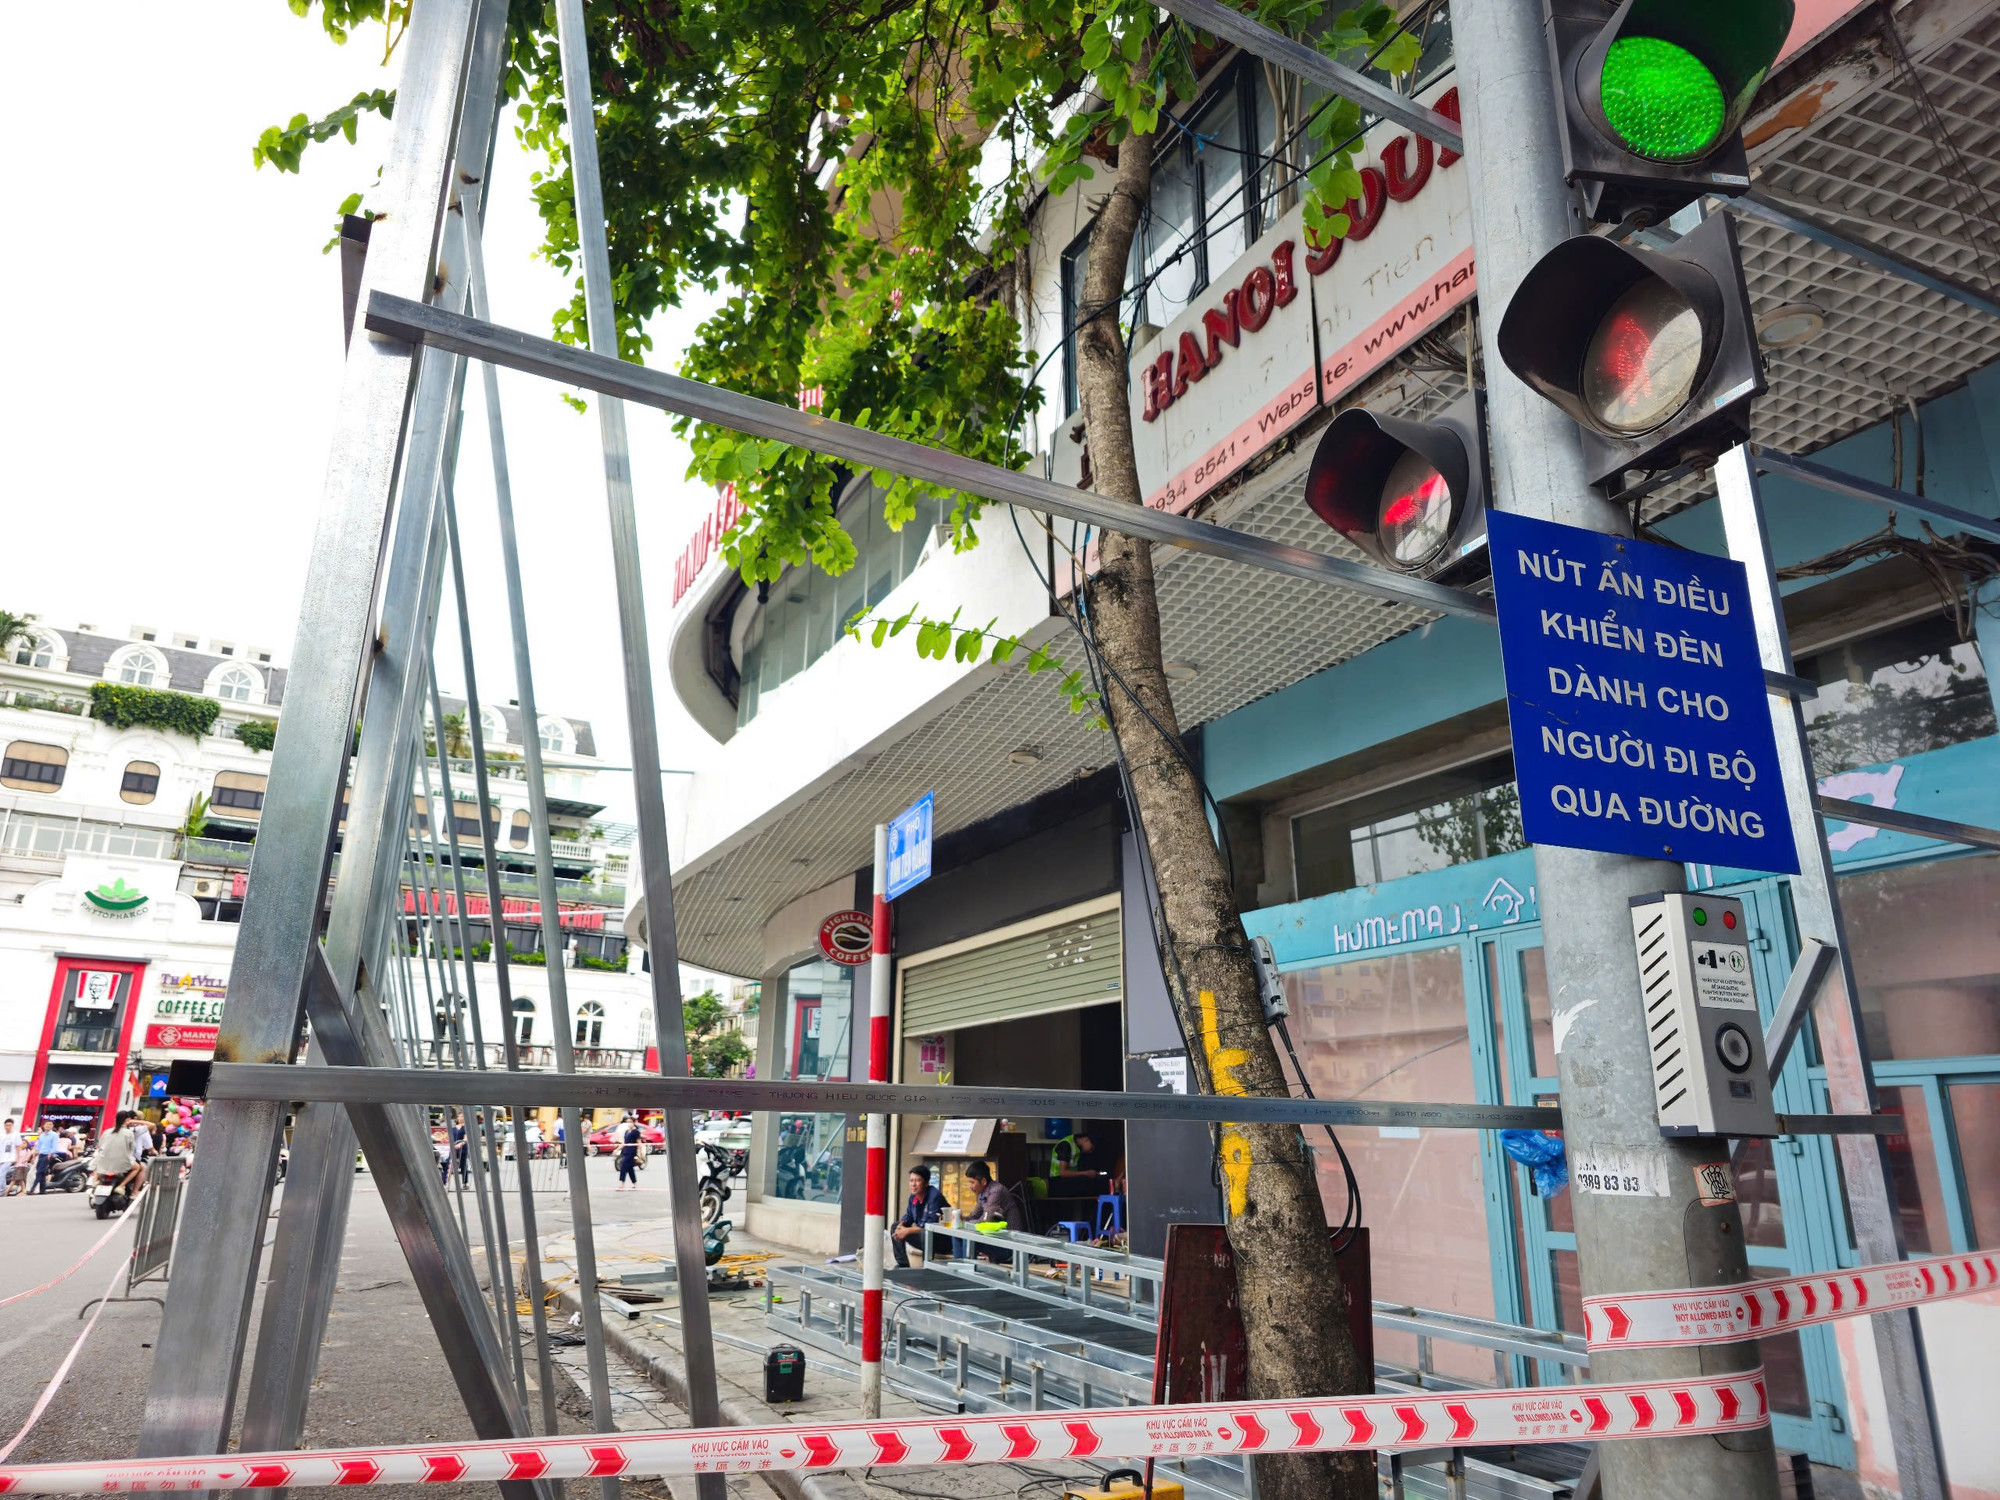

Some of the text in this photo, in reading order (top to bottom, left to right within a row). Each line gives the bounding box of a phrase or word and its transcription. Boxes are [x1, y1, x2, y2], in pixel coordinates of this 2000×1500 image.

[1141, 240, 1299, 422] HANOI
[1193, 444, 1236, 485] 8541
[1257, 356, 1354, 434] Webste:
[1517, 549, 1730, 616] NÚT ẤN ĐIỀU
[1540, 608, 1724, 668] KHIỂN ĐÈN
[1548, 664, 1730, 722] DÀNH CHO
[1541, 725, 1757, 792] NGƯỜI ĐI BỘ
[1550, 784, 1765, 839] QUA ĐƯỜNG
[80, 901, 149, 919] PHYTOPHARCO
[823, 914, 873, 934] HIGHLAN
[157, 1000, 207, 1015] COFFEE
[45, 1083, 102, 1100] KFC
[768, 1091, 818, 1100] THUONG
[825, 1092, 858, 1100] HIEU
[1603, 1175, 1619, 1191] 83
[1672, 1303, 1688, 1312] KHU
[1703, 1297, 1717, 1309] CẤM
[1717, 1297, 1730, 1307] VÀO
[1675, 1310, 1733, 1322] NOT ALLOWED AREA
[1146, 1415, 1208, 1431] KHU VỰC CẤM VÀO
[1148, 1429, 1213, 1439] NOT ALLOWED AREA
[691, 1437, 769, 1454] KHU VỰC CẤM VÀO
